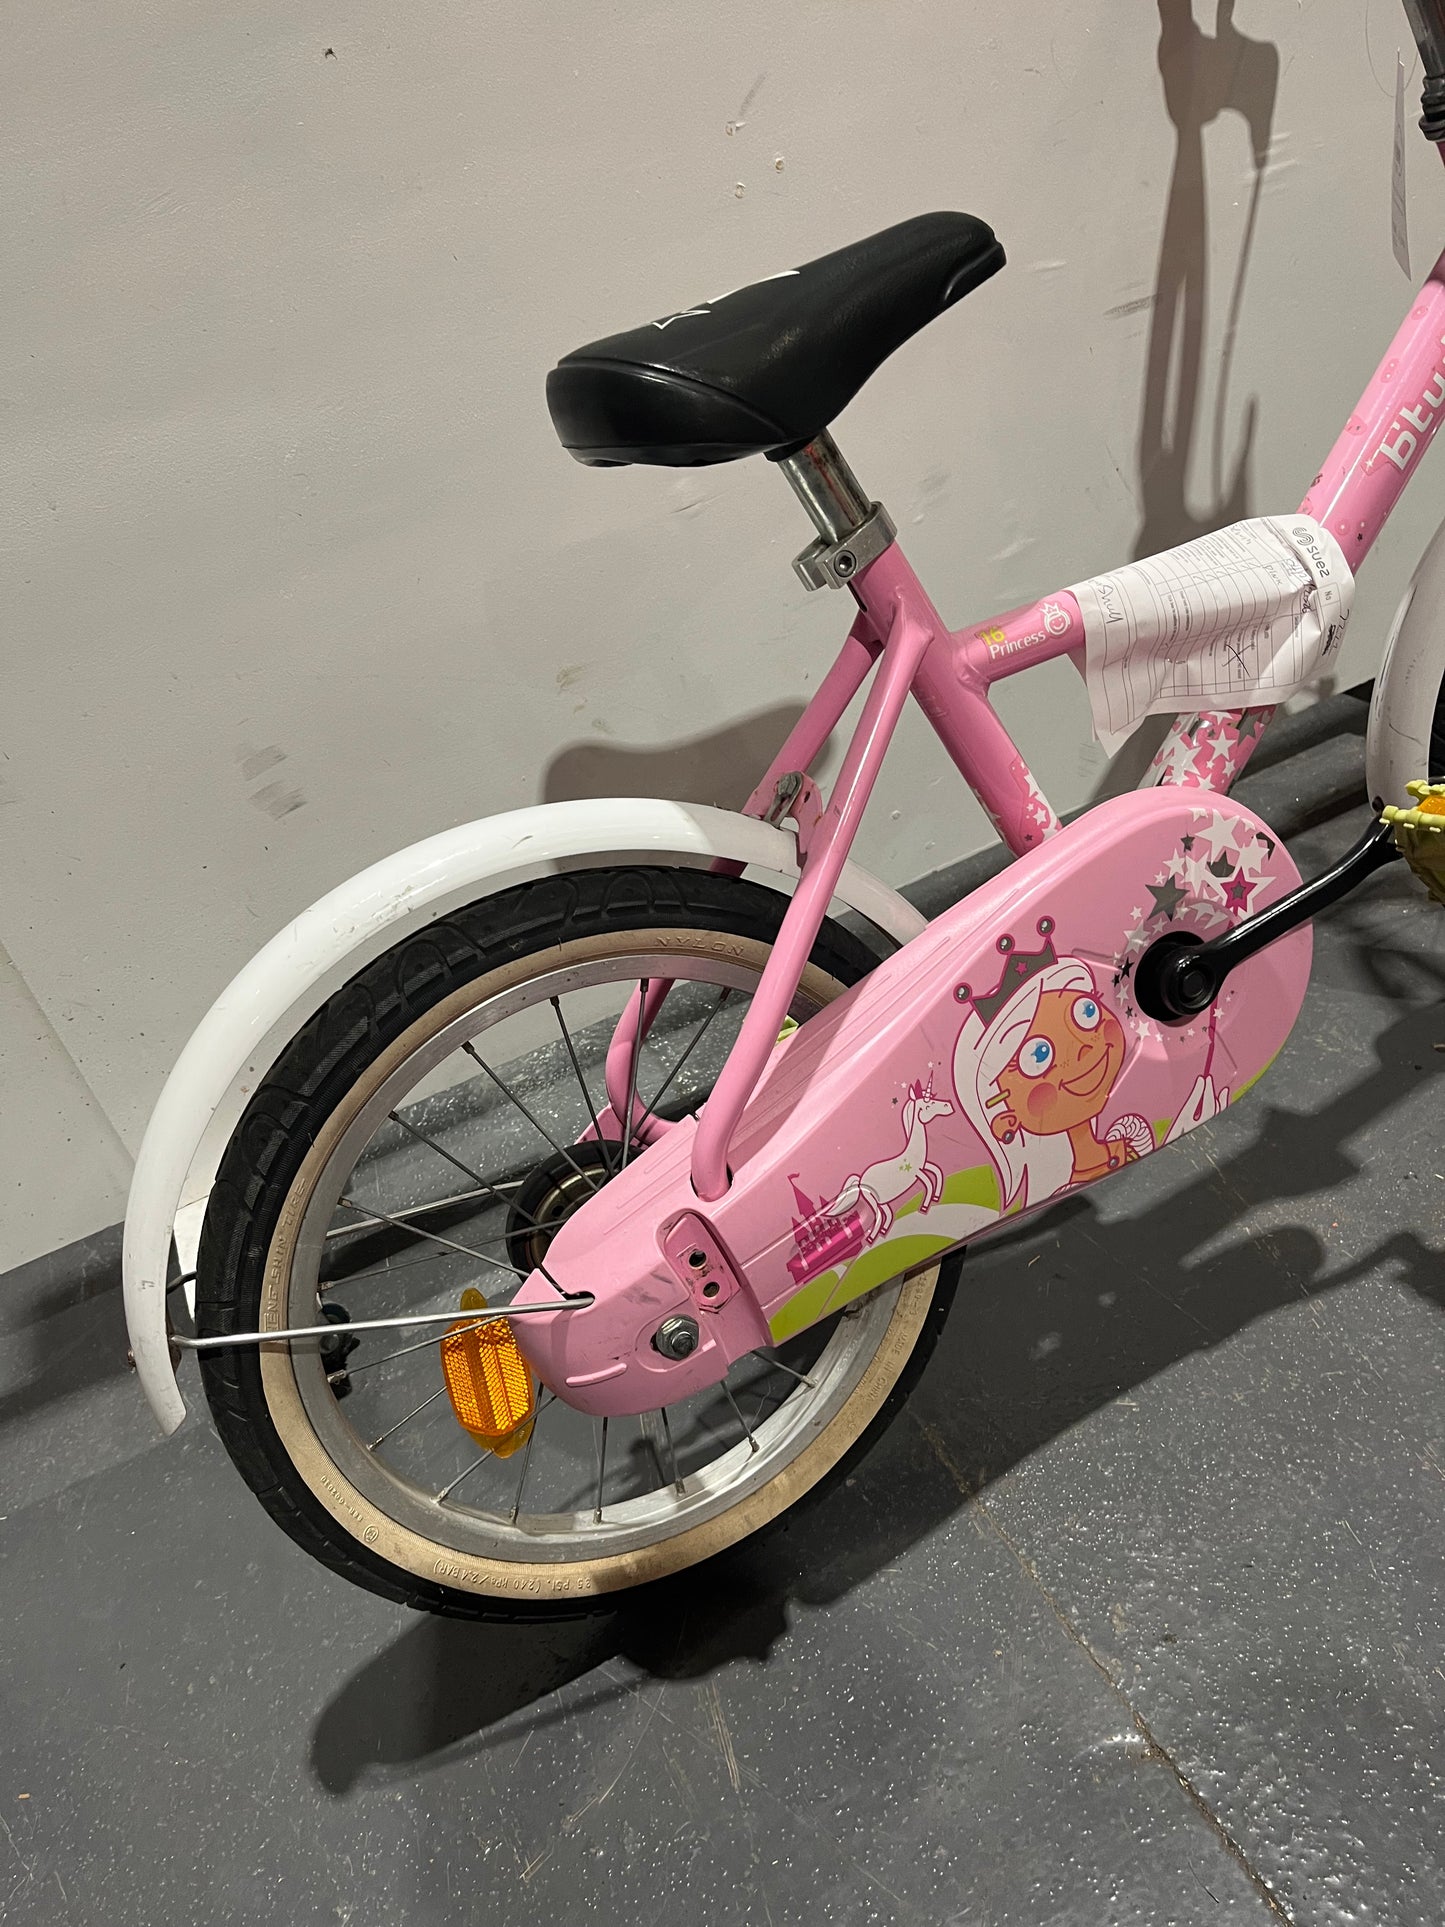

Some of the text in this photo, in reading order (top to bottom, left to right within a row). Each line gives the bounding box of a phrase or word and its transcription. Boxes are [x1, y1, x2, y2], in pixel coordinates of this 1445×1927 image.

[1306, 545, 1330, 578] suez
[979, 626, 1006, 647] 16
[989, 630, 1047, 660] Princess
[655, 936, 744, 957] NYLON
[282, 1178, 306, 1229] TIRE
